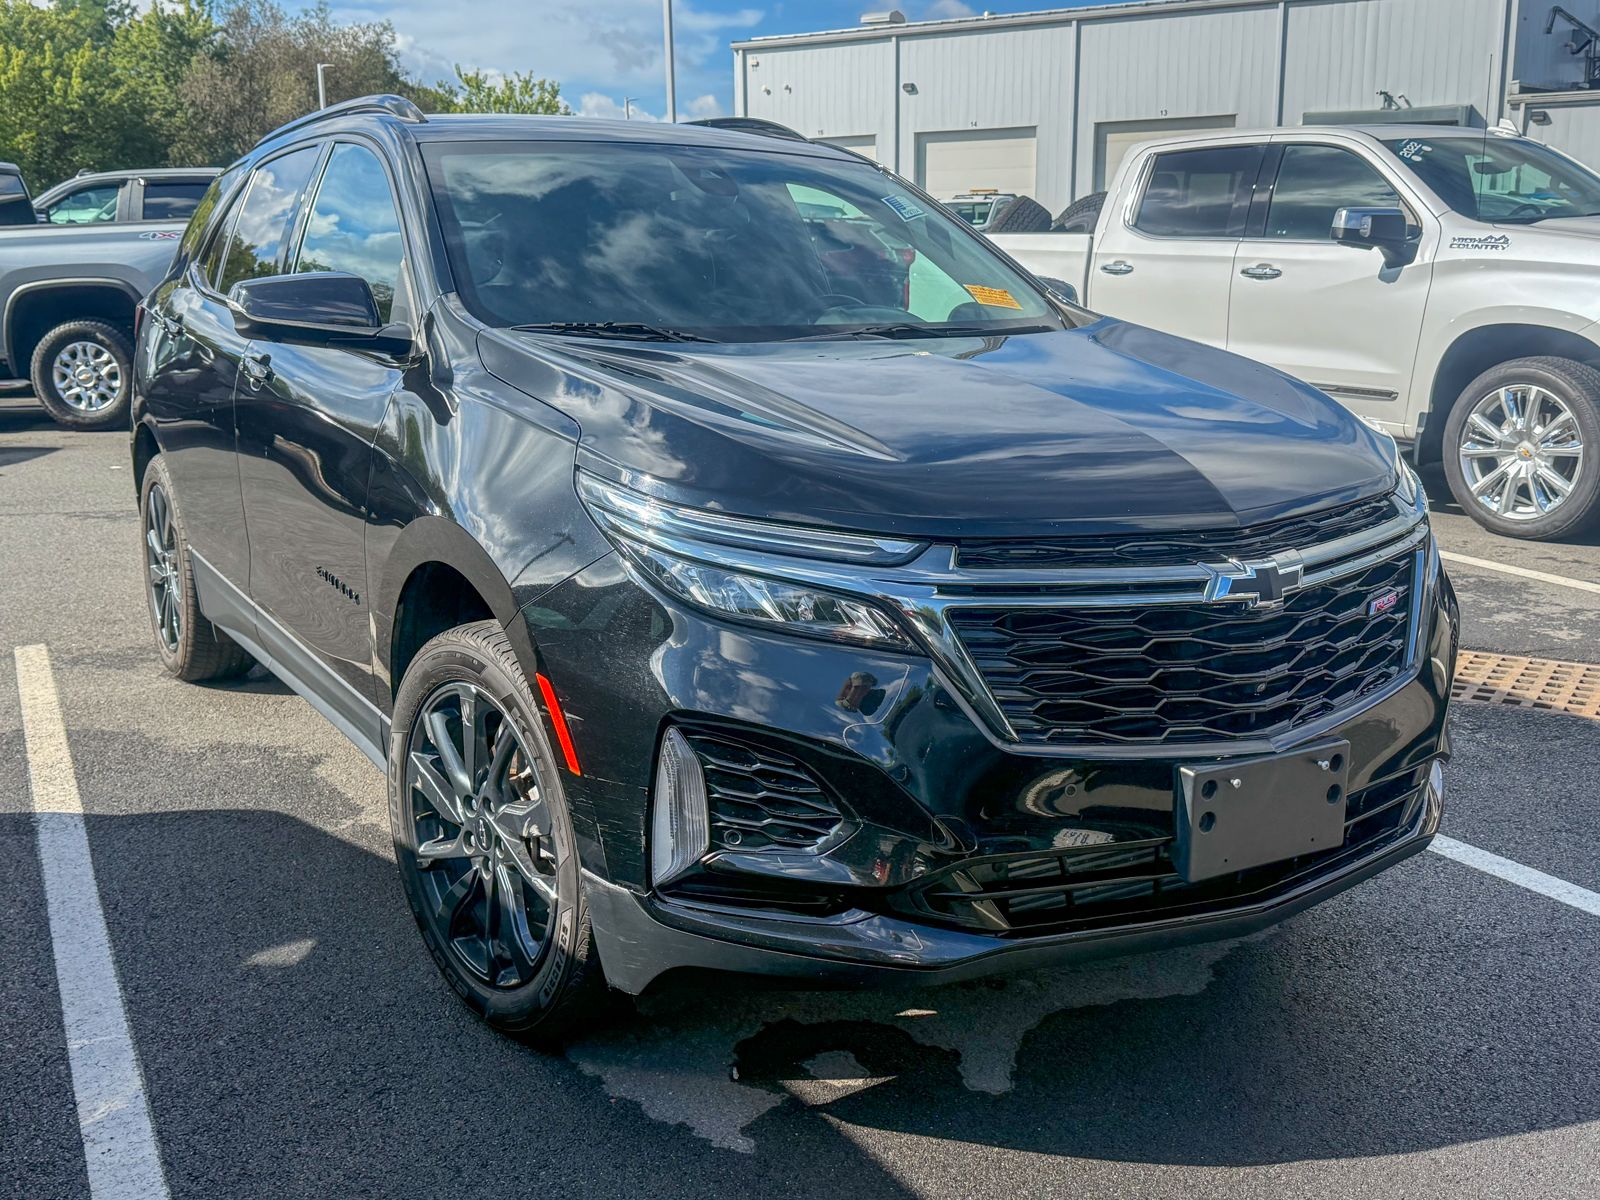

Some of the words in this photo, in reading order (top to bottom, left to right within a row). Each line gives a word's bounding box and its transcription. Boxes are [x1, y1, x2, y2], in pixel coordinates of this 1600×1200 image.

[1399, 141, 1422, 159] 2022
[139, 230, 184, 241] 4X
[1449, 243, 1510, 251] COUNTRY
[1370, 591, 1397, 614] RS
